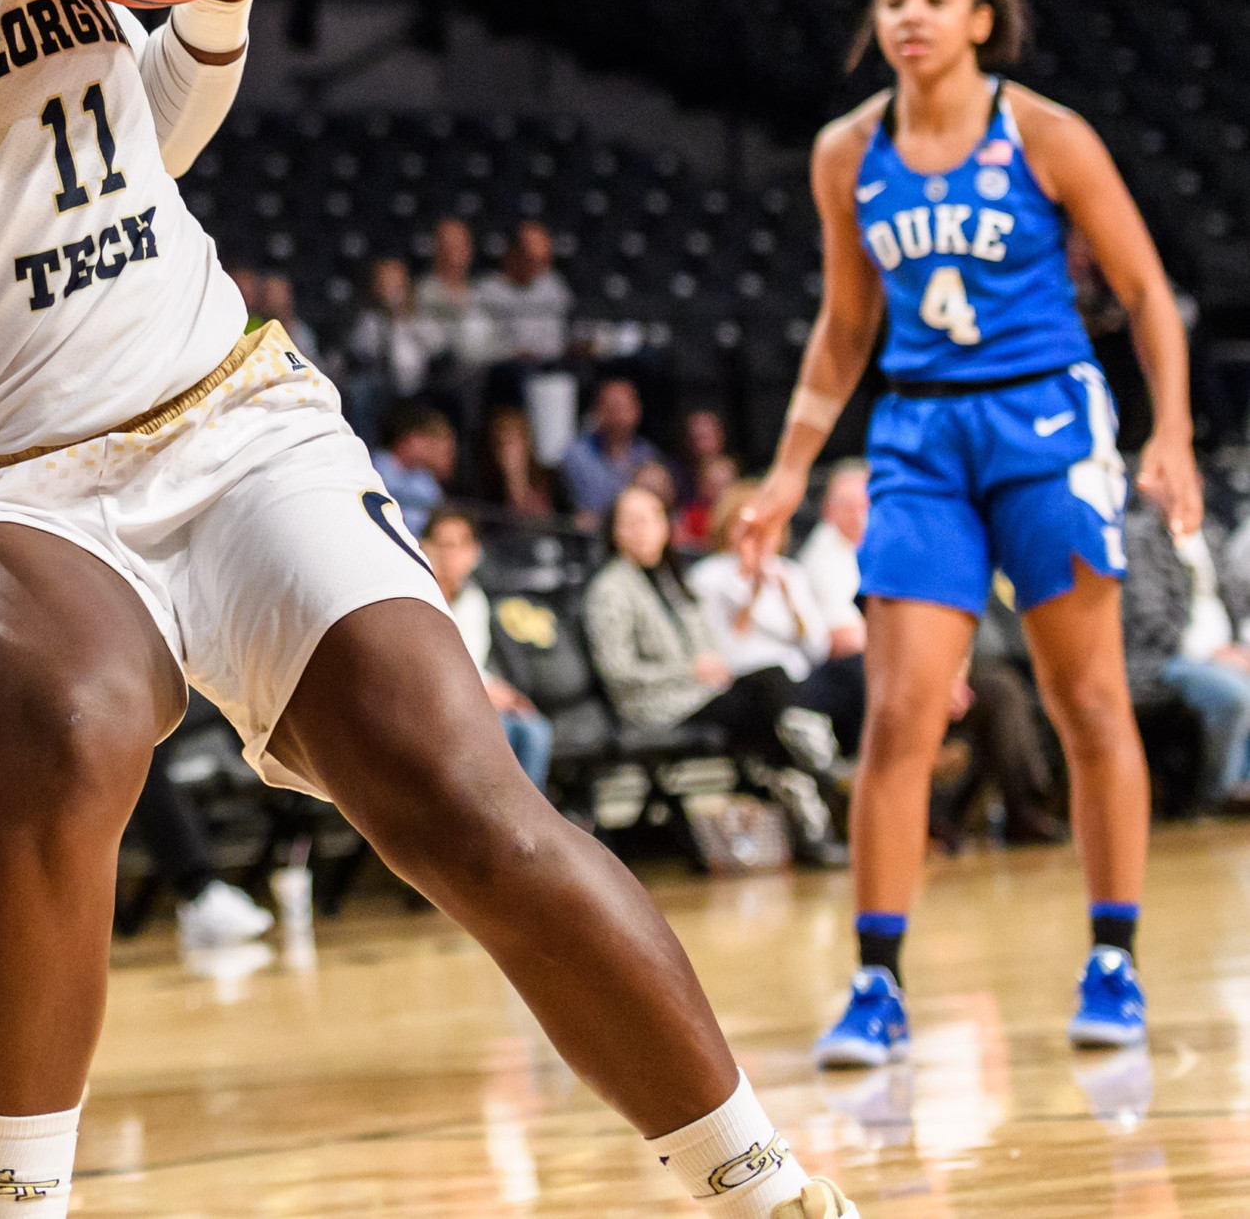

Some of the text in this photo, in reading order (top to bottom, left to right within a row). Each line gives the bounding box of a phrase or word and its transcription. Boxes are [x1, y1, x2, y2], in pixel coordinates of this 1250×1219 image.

[40, 79, 127, 216] 11
[868, 204, 1015, 271] DUKE
[920, 266, 981, 345] 4
